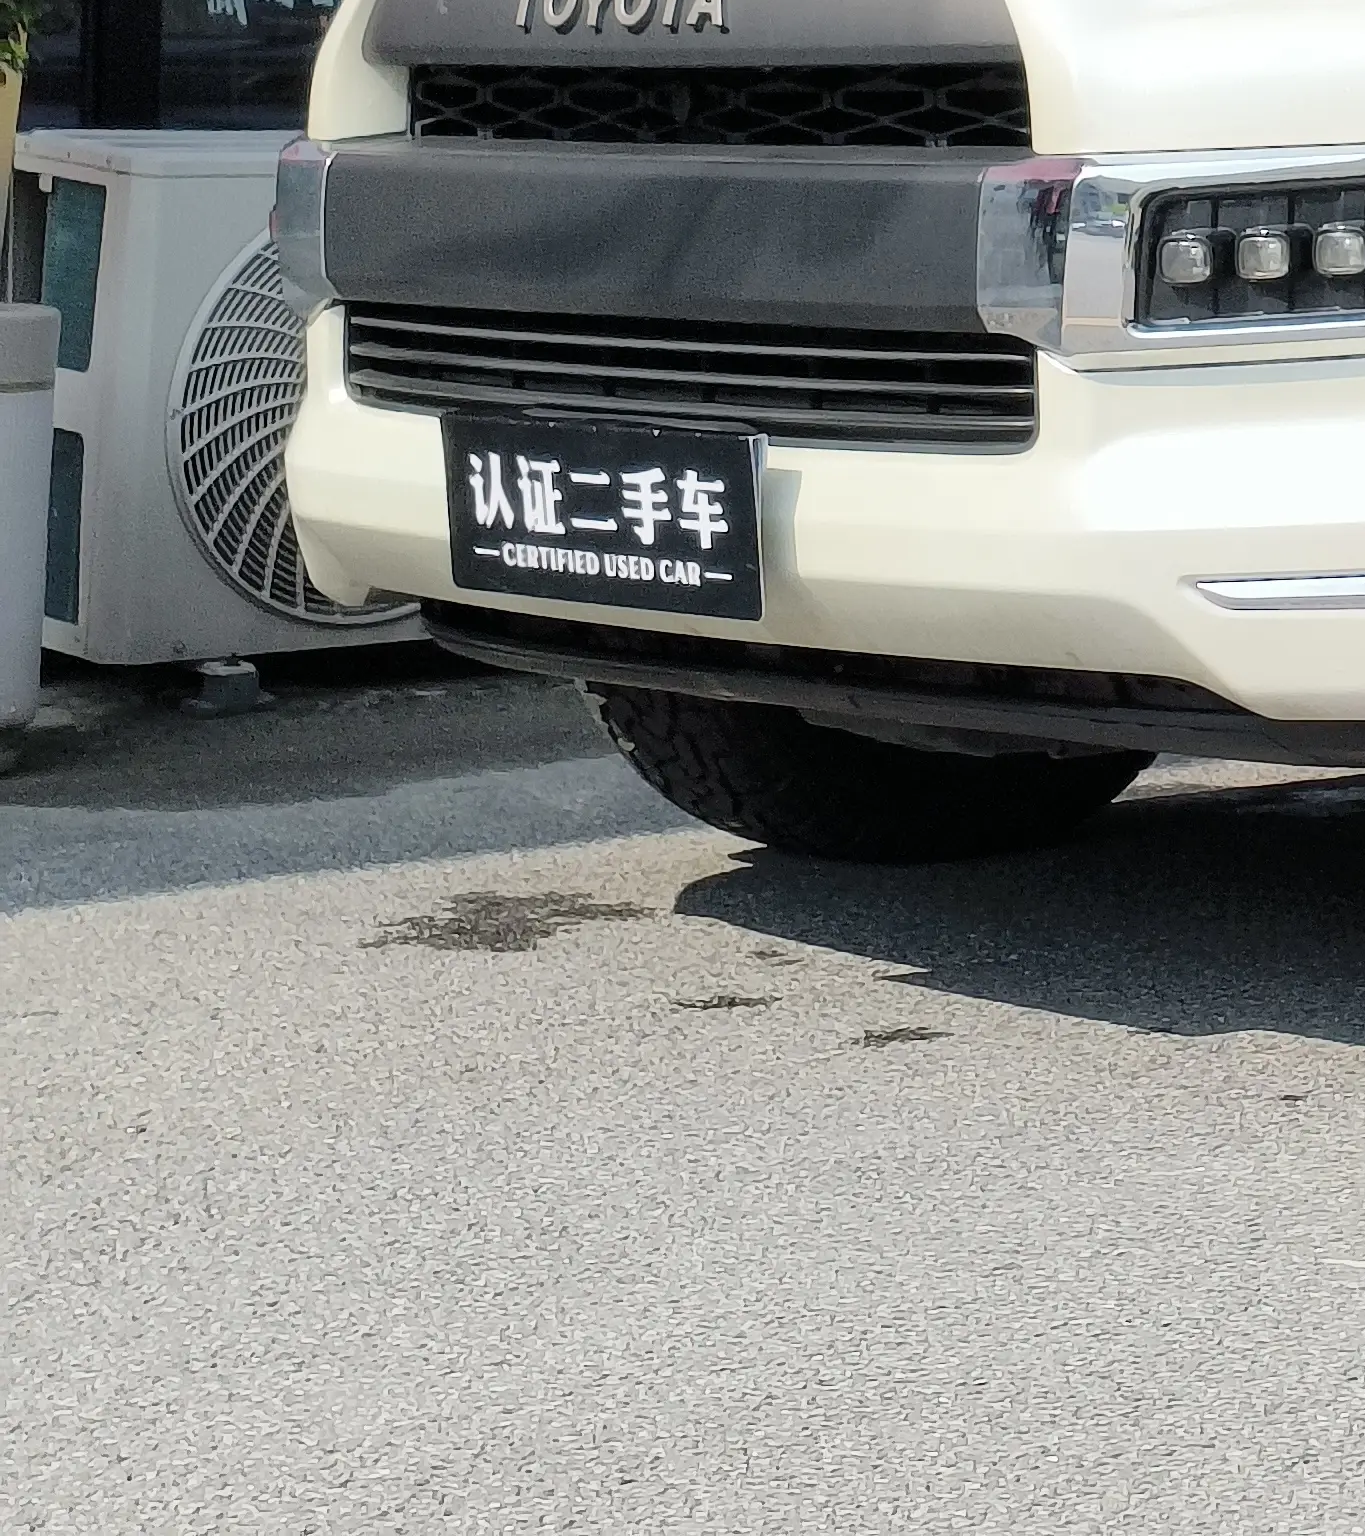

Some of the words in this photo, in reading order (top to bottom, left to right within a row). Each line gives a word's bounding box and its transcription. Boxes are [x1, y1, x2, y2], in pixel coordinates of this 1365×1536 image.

[468, 450, 730, 550] 认证二手车
[501, 540, 600, 576] CERTIFIED
[603, 552, 656, 581] USED
[658, 559, 702, 587] CAR
